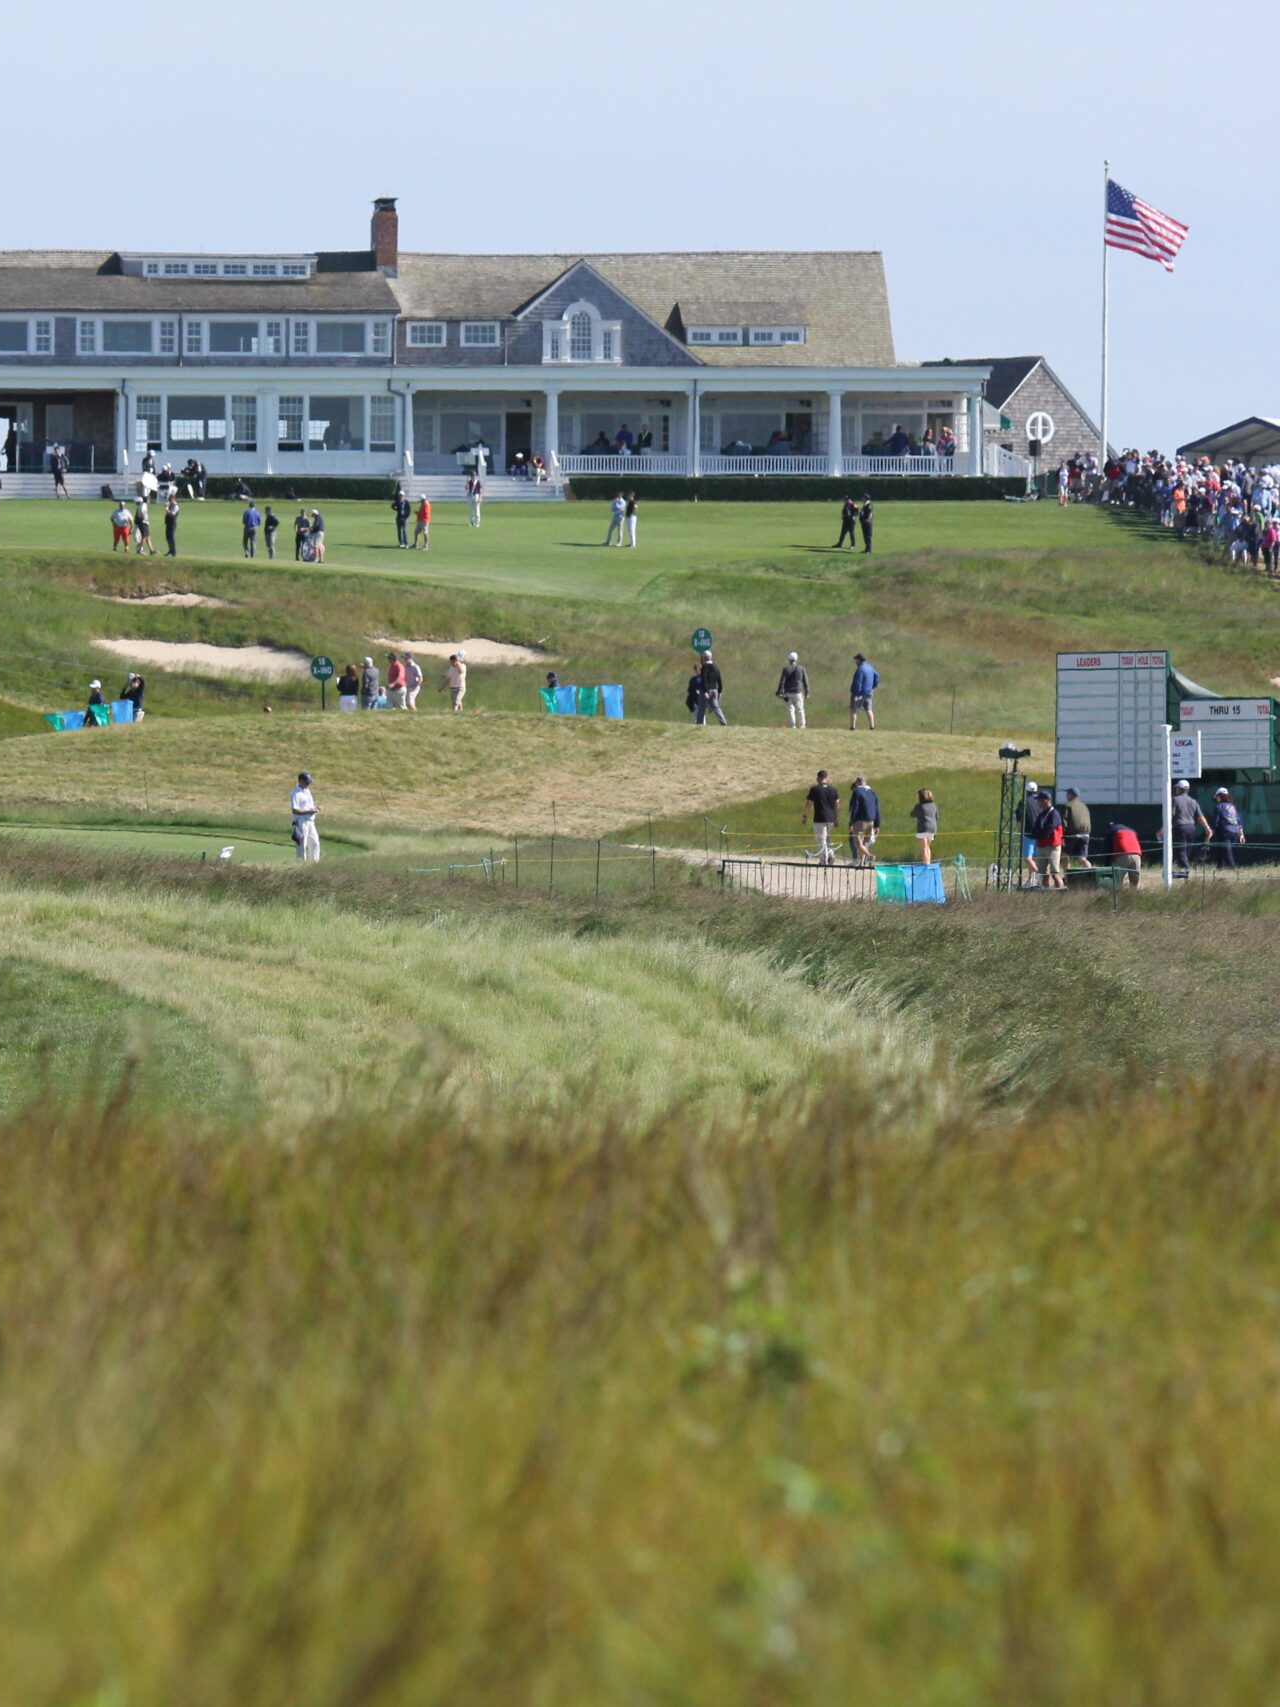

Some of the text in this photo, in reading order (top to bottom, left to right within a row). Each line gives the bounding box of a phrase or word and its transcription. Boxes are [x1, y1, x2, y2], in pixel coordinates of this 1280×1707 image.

[1076, 657, 1101, 667] LEADERS
[1209, 706, 1230, 716] THRU
[1232, 706, 1241, 715] 15
[1174, 739, 1193, 747] USGA
